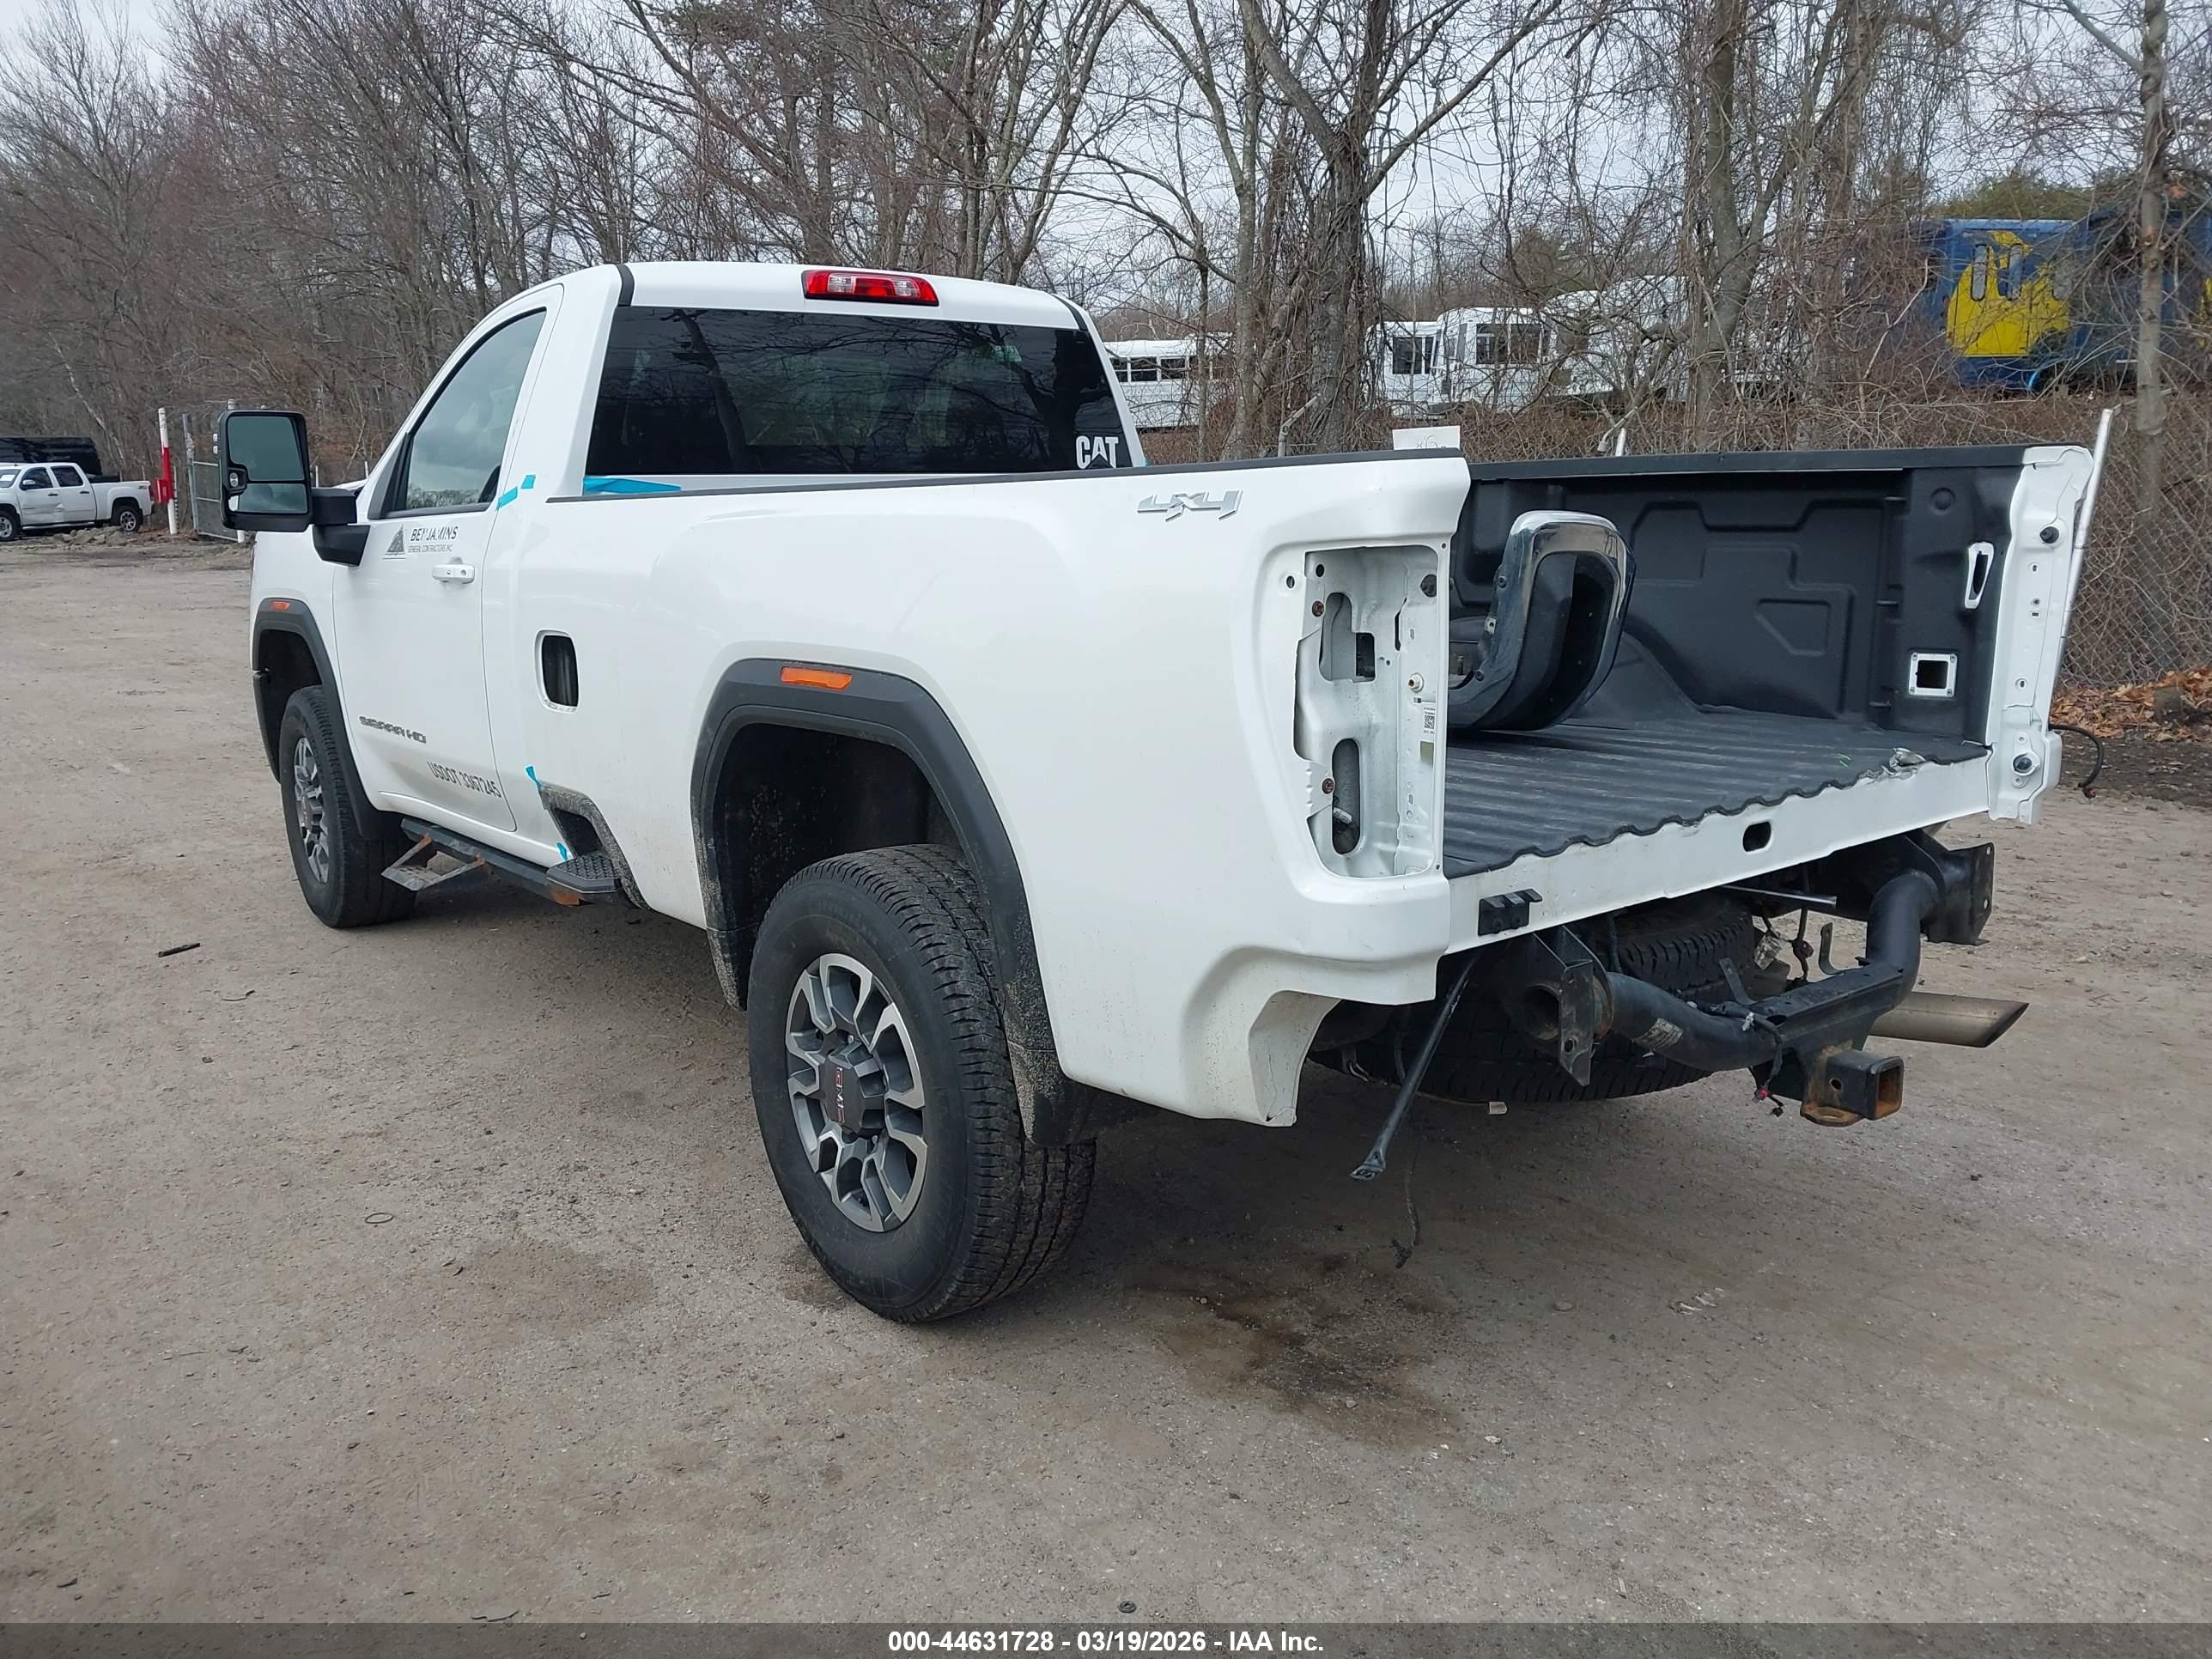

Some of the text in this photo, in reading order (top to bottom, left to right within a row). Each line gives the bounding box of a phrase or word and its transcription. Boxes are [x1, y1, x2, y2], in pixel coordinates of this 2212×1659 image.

[1075, 435, 1119, 470] CAT
[406, 729, 427, 744] HD
[427, 761, 462, 786] USDOT
